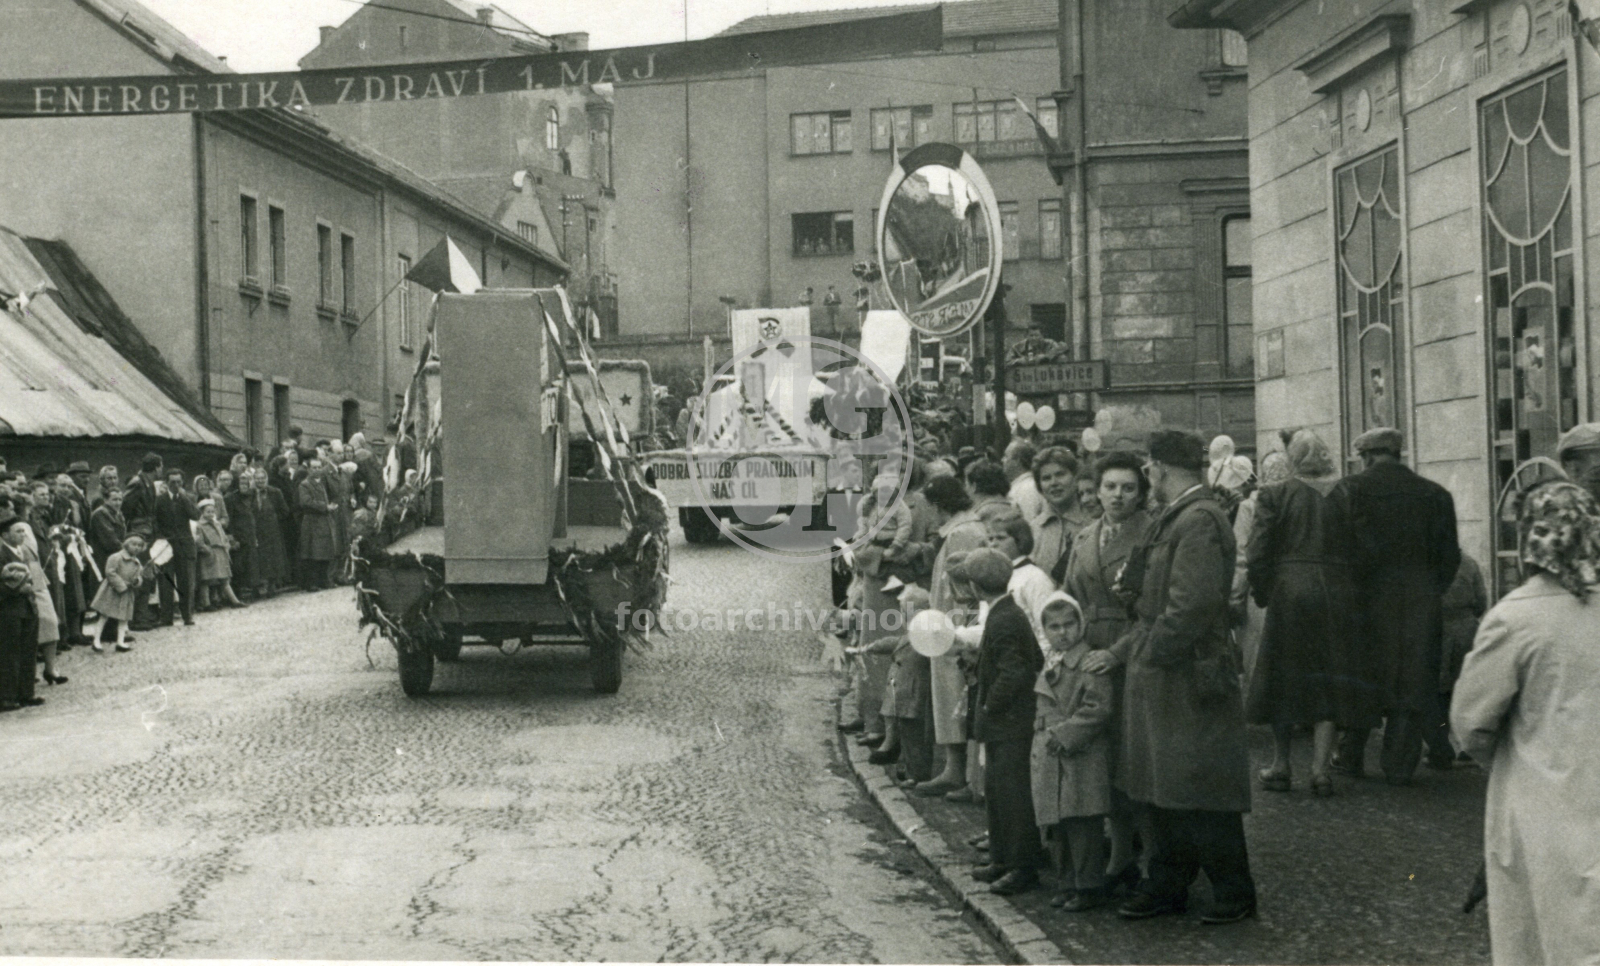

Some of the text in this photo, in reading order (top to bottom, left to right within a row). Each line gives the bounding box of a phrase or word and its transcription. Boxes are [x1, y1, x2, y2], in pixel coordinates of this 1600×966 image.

[31, 80, 312, 113] ENERGETIKA
[334, 58, 497, 104] ZDRAVÍ
[518, 64, 544, 90] 1.
[1034, 366, 1093, 382] Lukavice
